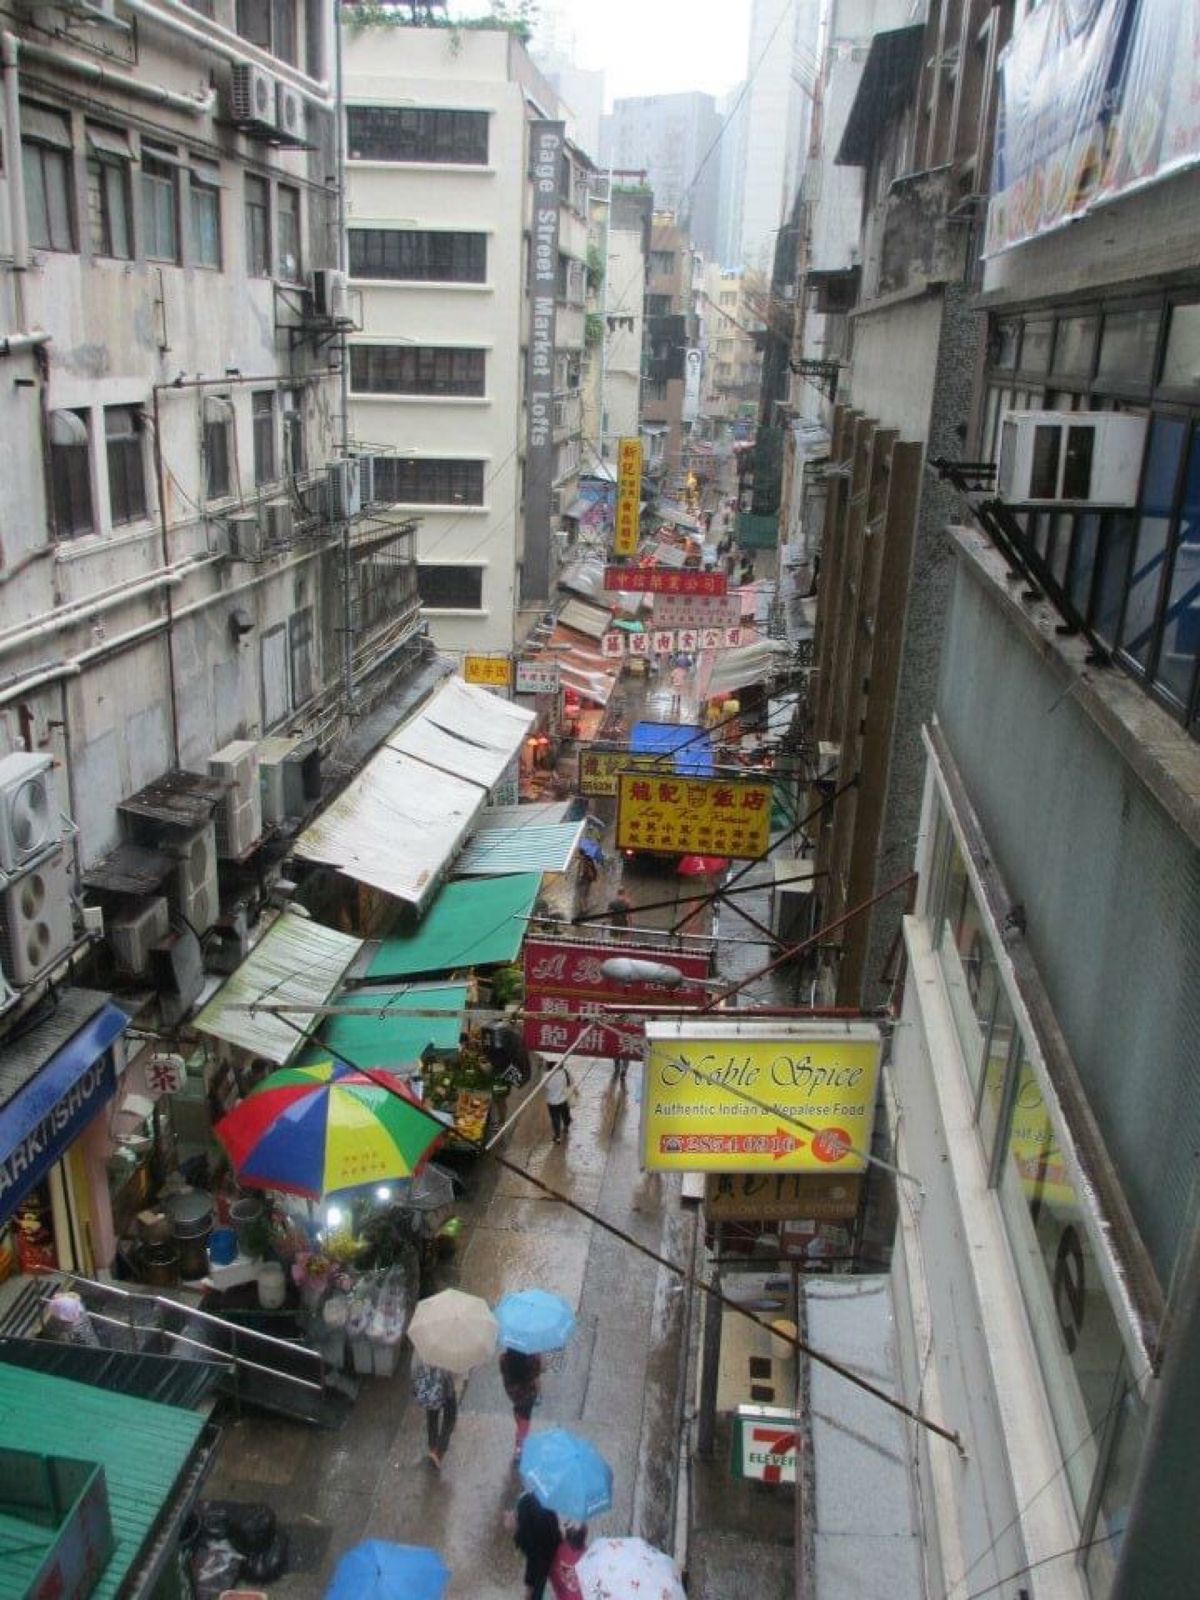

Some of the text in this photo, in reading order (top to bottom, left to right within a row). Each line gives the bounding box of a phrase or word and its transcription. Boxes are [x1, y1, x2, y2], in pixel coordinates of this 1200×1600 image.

[530, 133, 559, 447] Gage Street Market Lofts
[150, 1064, 177, 1091] 茶
[660, 1054, 864, 1098] Noble Spice
[654, 1103, 716, 1116] Authentic
[719, 1103, 758, 1116] Indian
[772, 1104, 830, 1119] Nepalese
[832, 1103, 865, 1116] Food
[752, 1427, 801, 1485] 7
